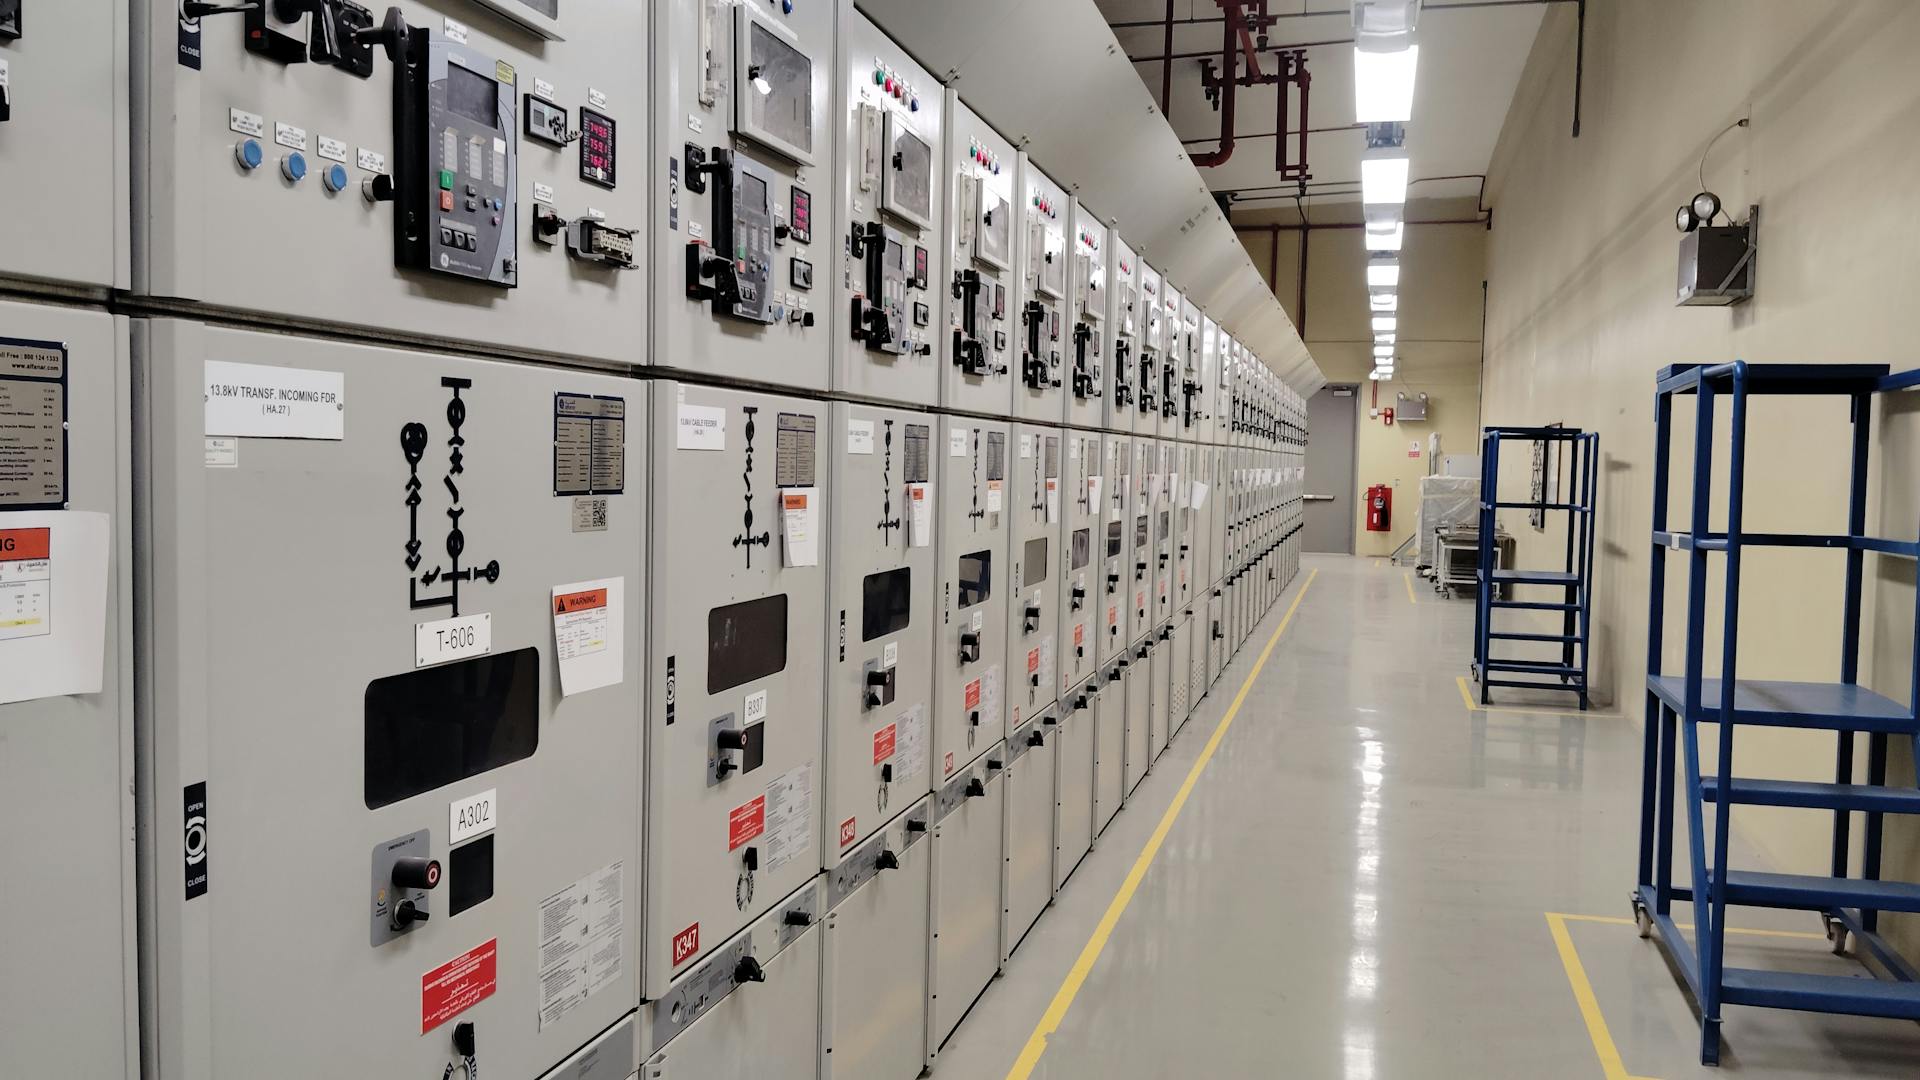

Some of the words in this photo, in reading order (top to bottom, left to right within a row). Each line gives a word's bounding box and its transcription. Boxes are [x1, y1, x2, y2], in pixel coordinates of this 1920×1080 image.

[179, 44, 200, 58] CLOSE
[6, 351, 19, 359] Free
[210, 384, 239, 397] 13.8kV
[240, 386, 277, 400] TRANSF.
[278, 389, 319, 402] INCOMING
[320, 392, 336, 404] FDR
[266, 405, 286, 414] HA.27
[569, 595, 596, 607] WARNING
[436, 625, 475, 652] T-606
[747, 696, 764, 717] B337
[188, 802, 204, 812] OPEN
[458, 800, 489, 832] A302
[187, 875, 205, 887] CLOSE
[674, 929, 698, 961] K347
